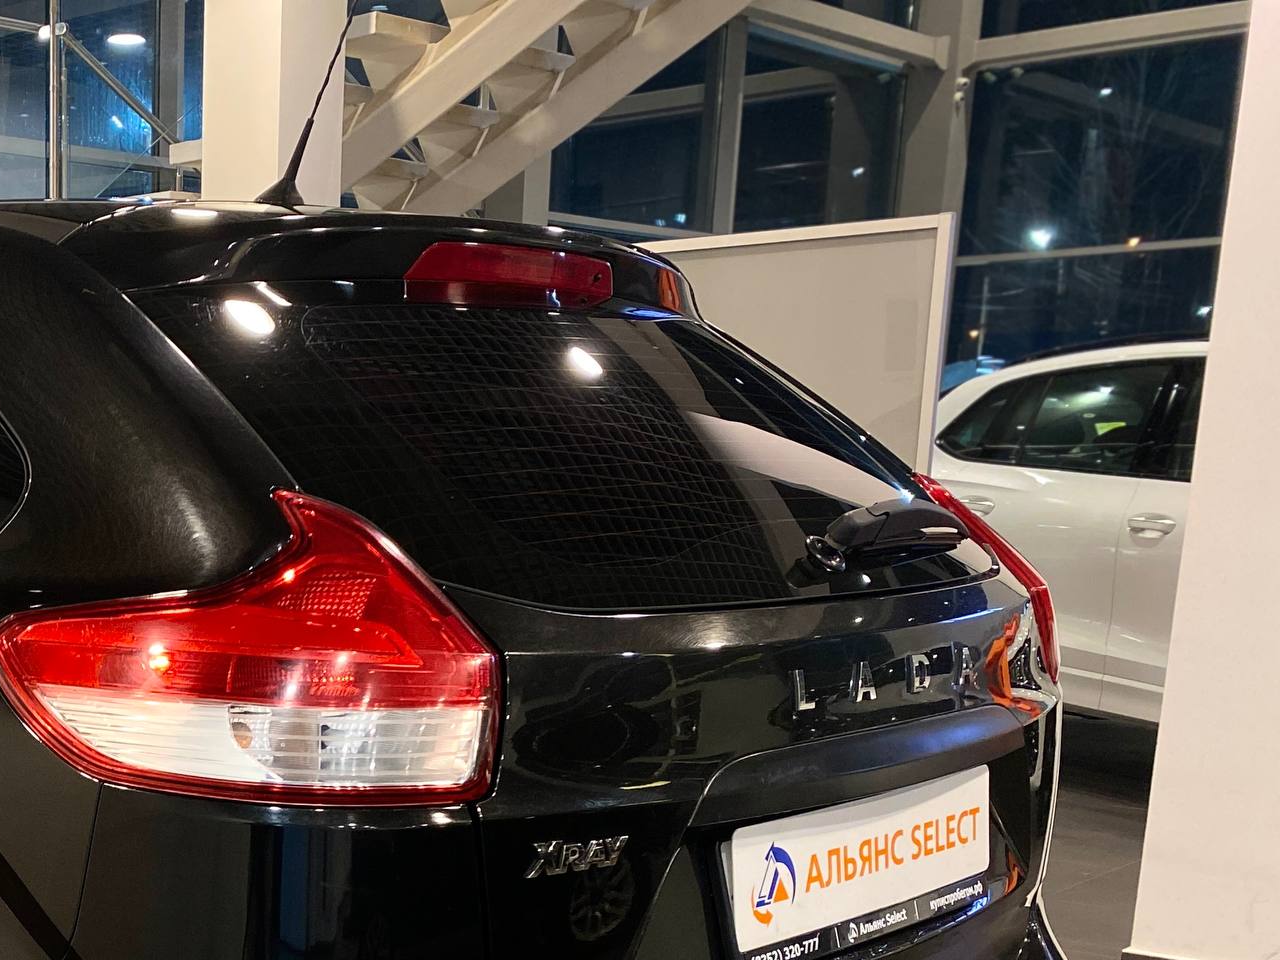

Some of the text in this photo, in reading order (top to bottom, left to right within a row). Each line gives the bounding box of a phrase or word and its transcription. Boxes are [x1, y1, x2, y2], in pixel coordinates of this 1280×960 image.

[805, 806, 981, 893] АЛЬЯНС SELECT
[858, 908, 908, 937] Альянс Select
[783, 936, 819, 960] 320-777
